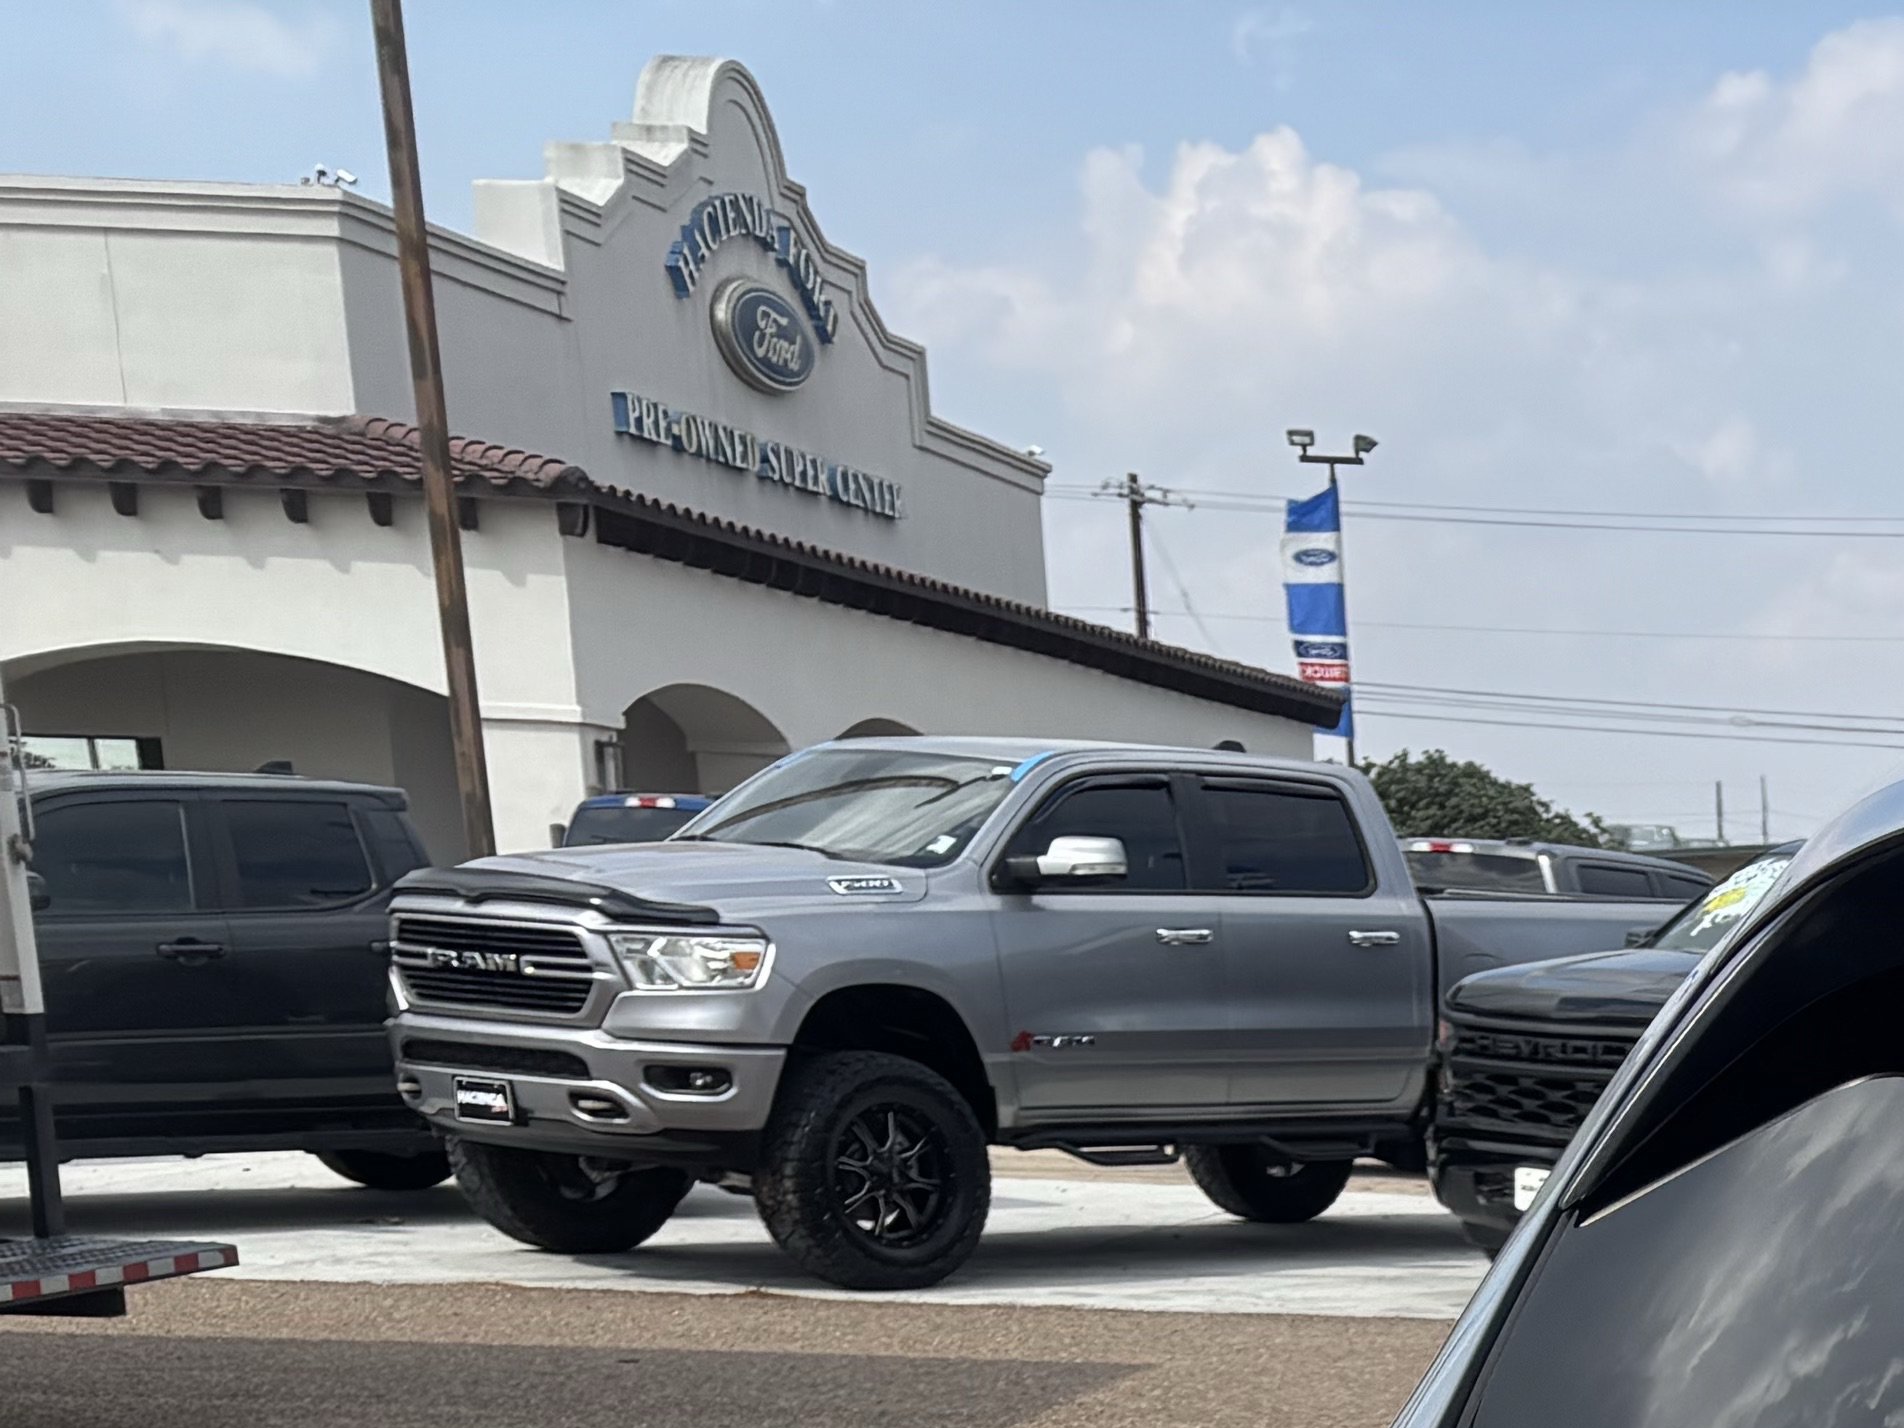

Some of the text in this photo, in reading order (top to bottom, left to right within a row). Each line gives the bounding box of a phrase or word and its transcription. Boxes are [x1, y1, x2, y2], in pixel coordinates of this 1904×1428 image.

[670, 193, 839, 343] HACIENDA FORD
[753, 304, 803, 372] Ford
[620, 393, 904, 519] PRE-OWNED SUPER CENTER
